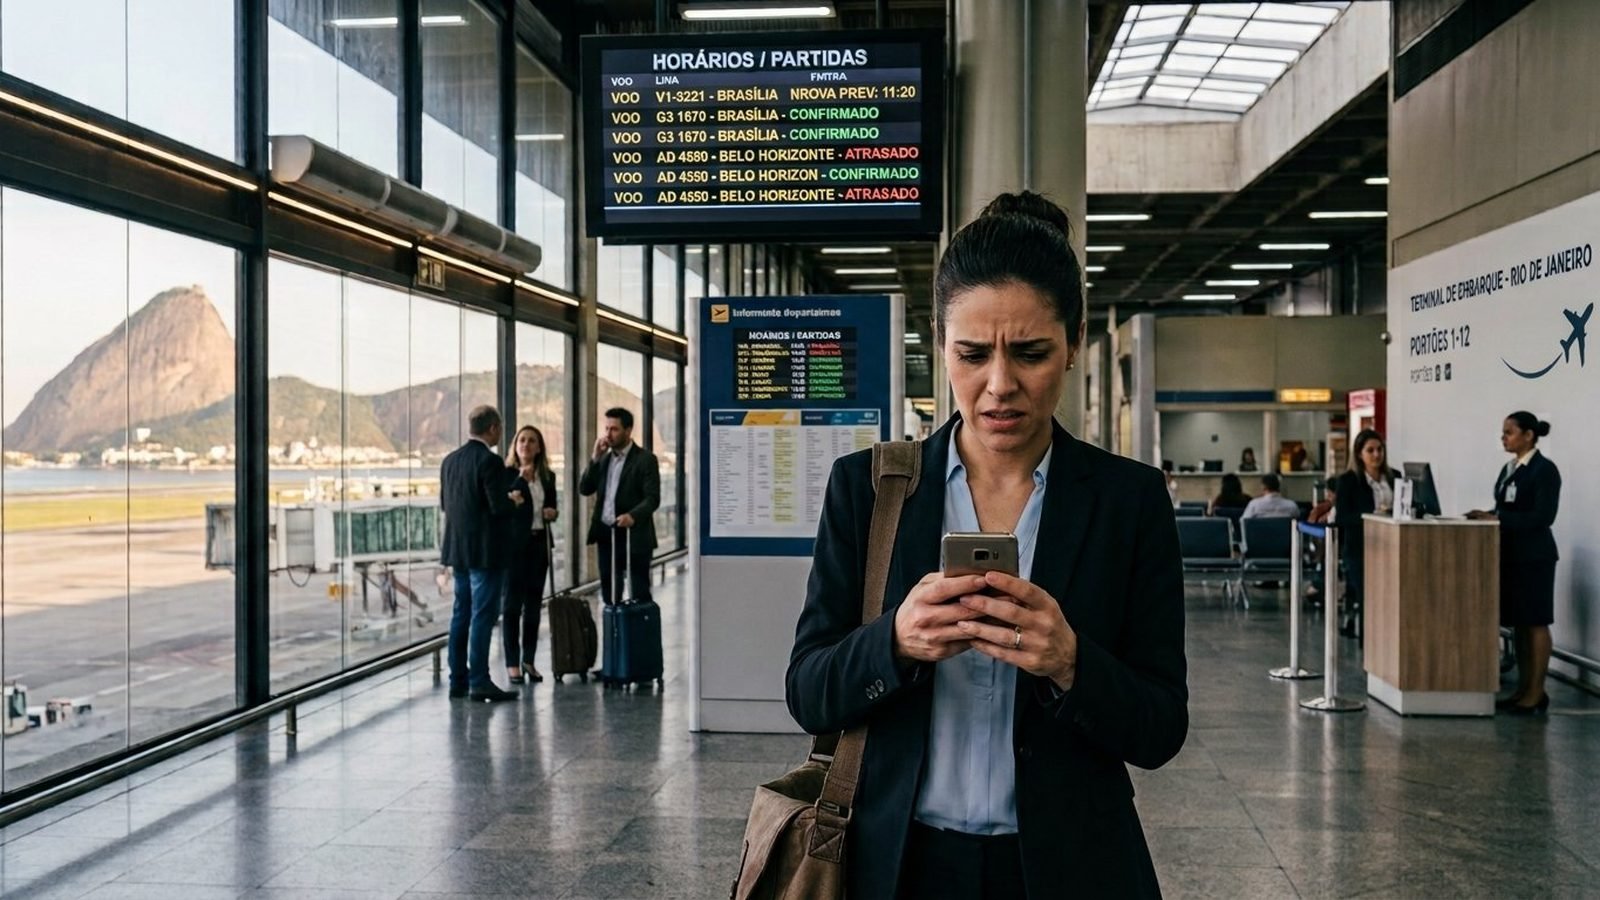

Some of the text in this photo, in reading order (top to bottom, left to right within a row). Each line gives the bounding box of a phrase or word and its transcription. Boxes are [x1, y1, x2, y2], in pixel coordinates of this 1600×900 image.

[653, 49, 867, 70] HORÁRIOS / PARTIDAS
[611, 77, 633, 86] VOO
[656, 76, 679, 85] LINA
[611, 92, 640, 104] VOO
[656, 90, 704, 102] V1-3221
[717, 86, 778, 101] BRASÍLIA
[791, 88, 836, 100] NROVA
[840, 87, 878, 99] PREV:
[882, 86, 915, 98] 11:20
[612, 112, 640, 124] VOO
[656, 111, 674, 123] G3
[678, 111, 706, 122] 1670
[718, 107, 779, 121] BRASÍLIA
[790, 107, 879, 120] CONFIRMADO
[612, 132, 641, 144] VOO
[657, 131, 674, 143] G3
[678, 130, 707, 142] 1670
[718, 127, 779, 141] BRASÍLIA
[790, 127, 879, 140] CONFIRMADO
[613, 152, 642, 164] VOO
[657, 151, 676, 163] AD
[720, 150, 755, 162] BELO
[759, 148, 834, 161] HORIZONTE
[845, 147, 919, 159] ATRASADO
[614, 172, 642, 183] VOO
[657, 171, 676, 183] AD
[720, 170, 755, 182] BELO
[759, 169, 818, 181] HORIZON
[829, 167, 919, 180] CONFIRMADO
[614, 192, 643, 204] VOO
[657, 191, 677, 203] AD
[720, 190, 755, 202] BELO
[759, 189, 835, 201] HORIZONTE
[845, 187, 919, 200] ATRASADO
[1410, 288, 1445, 312] TERMINAL
[1446, 284, 1456, 303] DE
[1511, 264, 1527, 286] RIO
[1529, 259, 1542, 281] DE
[1544, 244, 1592, 277] JANEIRO
[1411, 328, 1448, 356] PORTÕES
